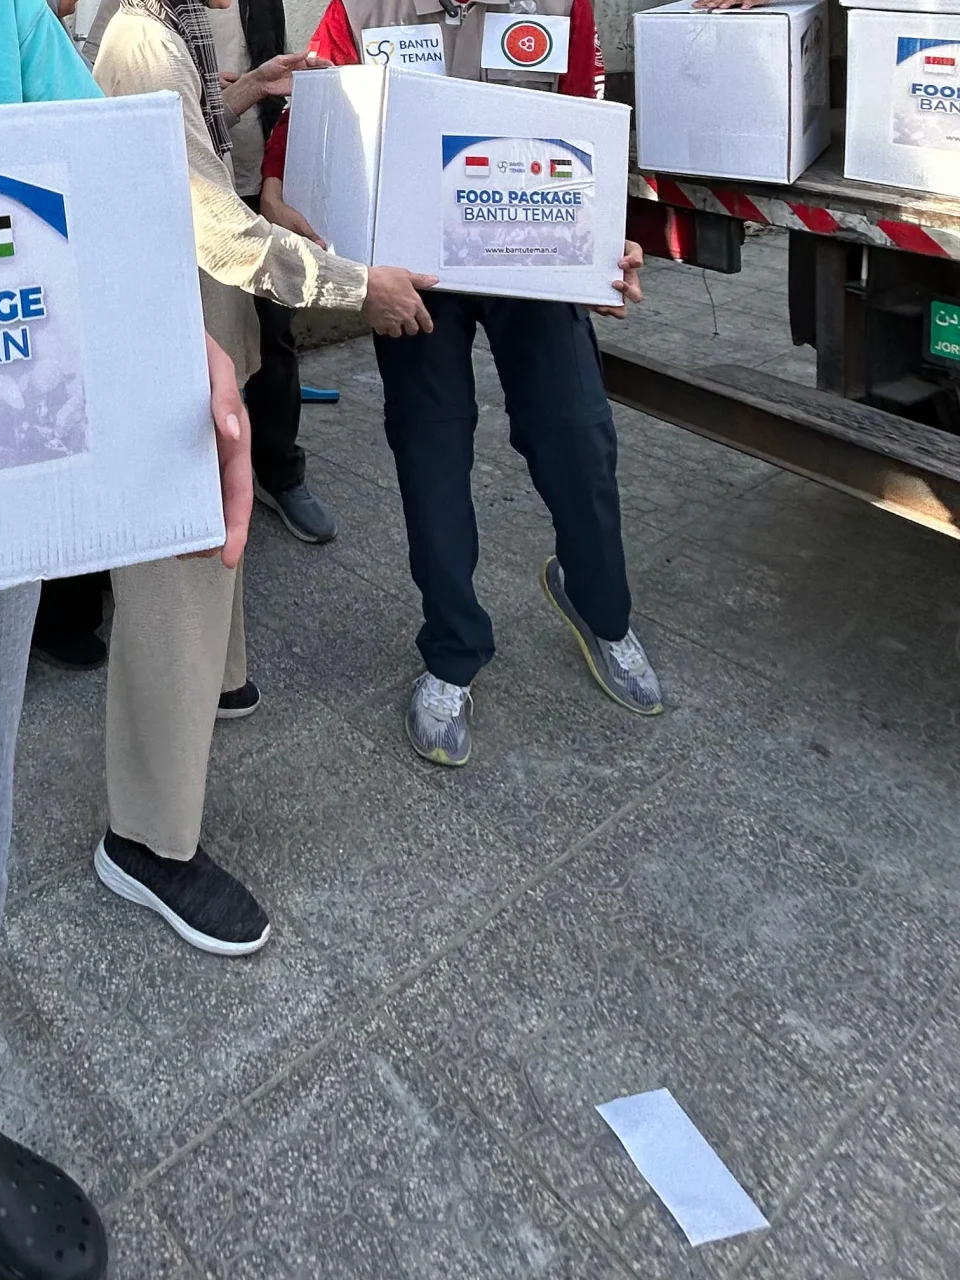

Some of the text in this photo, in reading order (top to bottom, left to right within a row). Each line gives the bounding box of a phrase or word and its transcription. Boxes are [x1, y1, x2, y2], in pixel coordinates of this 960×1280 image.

[399, 38, 439, 50] BANTU
[400, 52, 442, 63] TEMAN
[911, 83, 960, 99] FOO
[456, 190, 582, 205] FOOD PACKAGE
[464, 207, 575, 221] BANTU TEMAN
[485, 246, 558, 254] www.bantuteman.id
